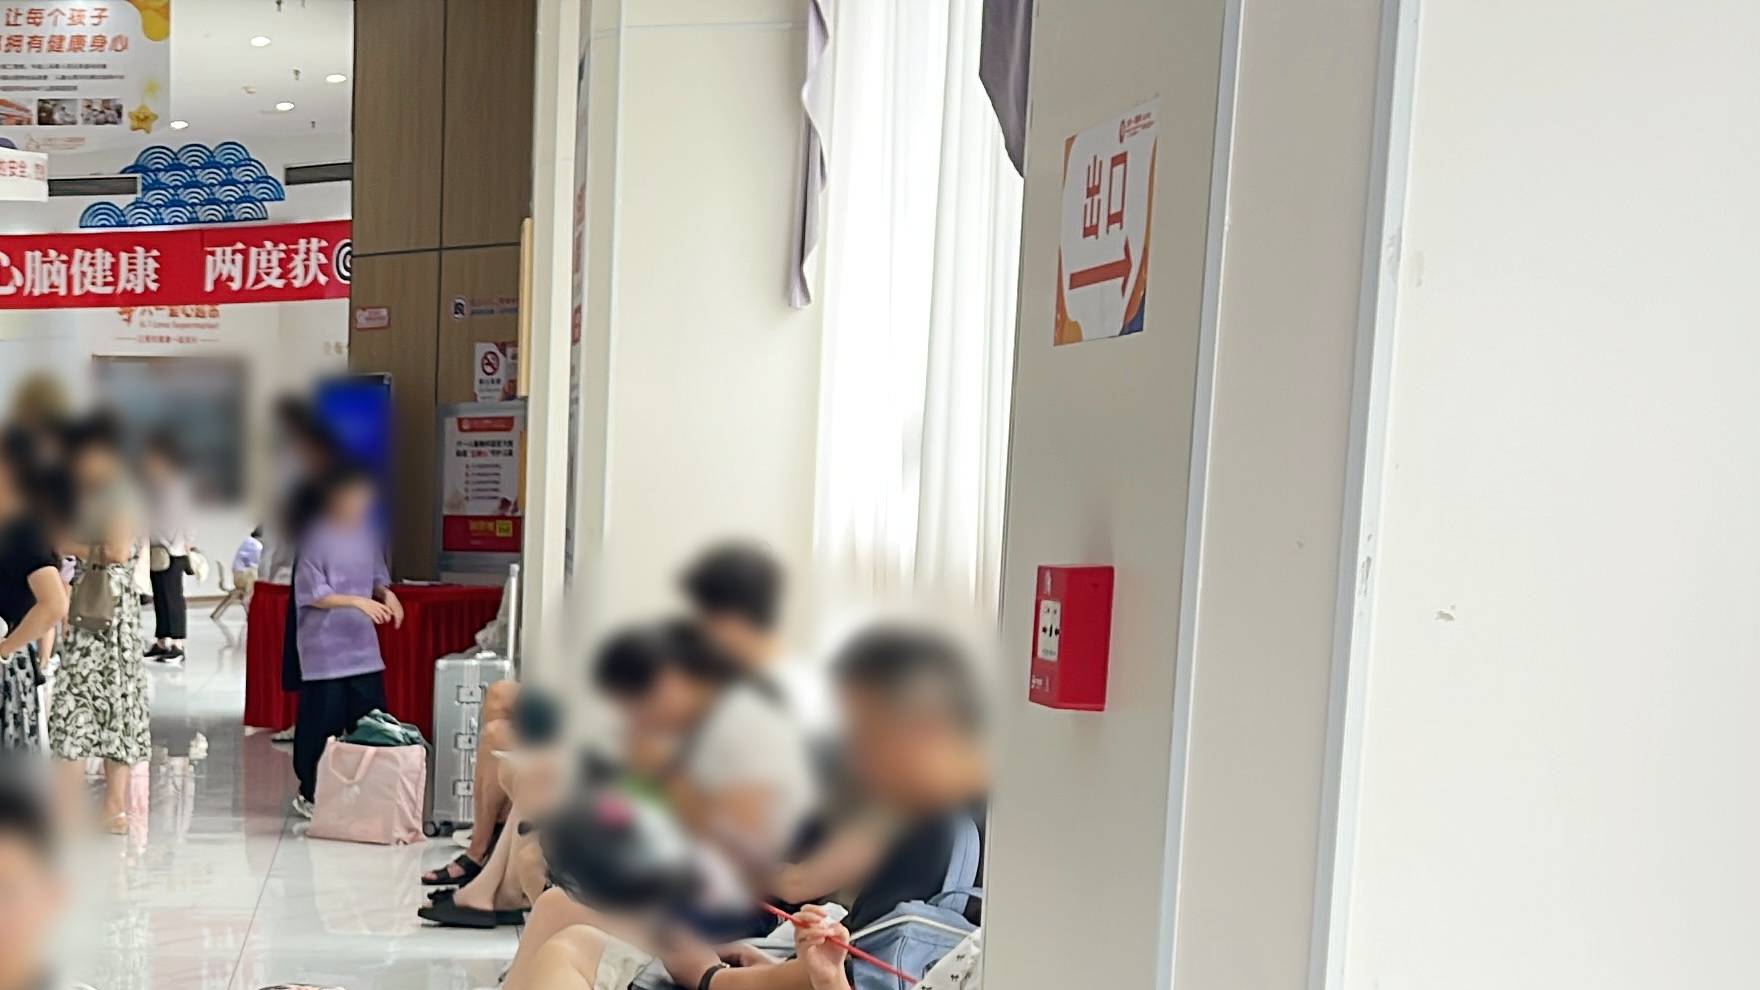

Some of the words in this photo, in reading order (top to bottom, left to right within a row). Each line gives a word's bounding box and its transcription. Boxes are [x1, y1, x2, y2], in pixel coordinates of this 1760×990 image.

[5, 7, 109, 27] 让每个孩子
[1082, 150, 1128, 240] 出口
[203, 237, 331, 293] 两度获
